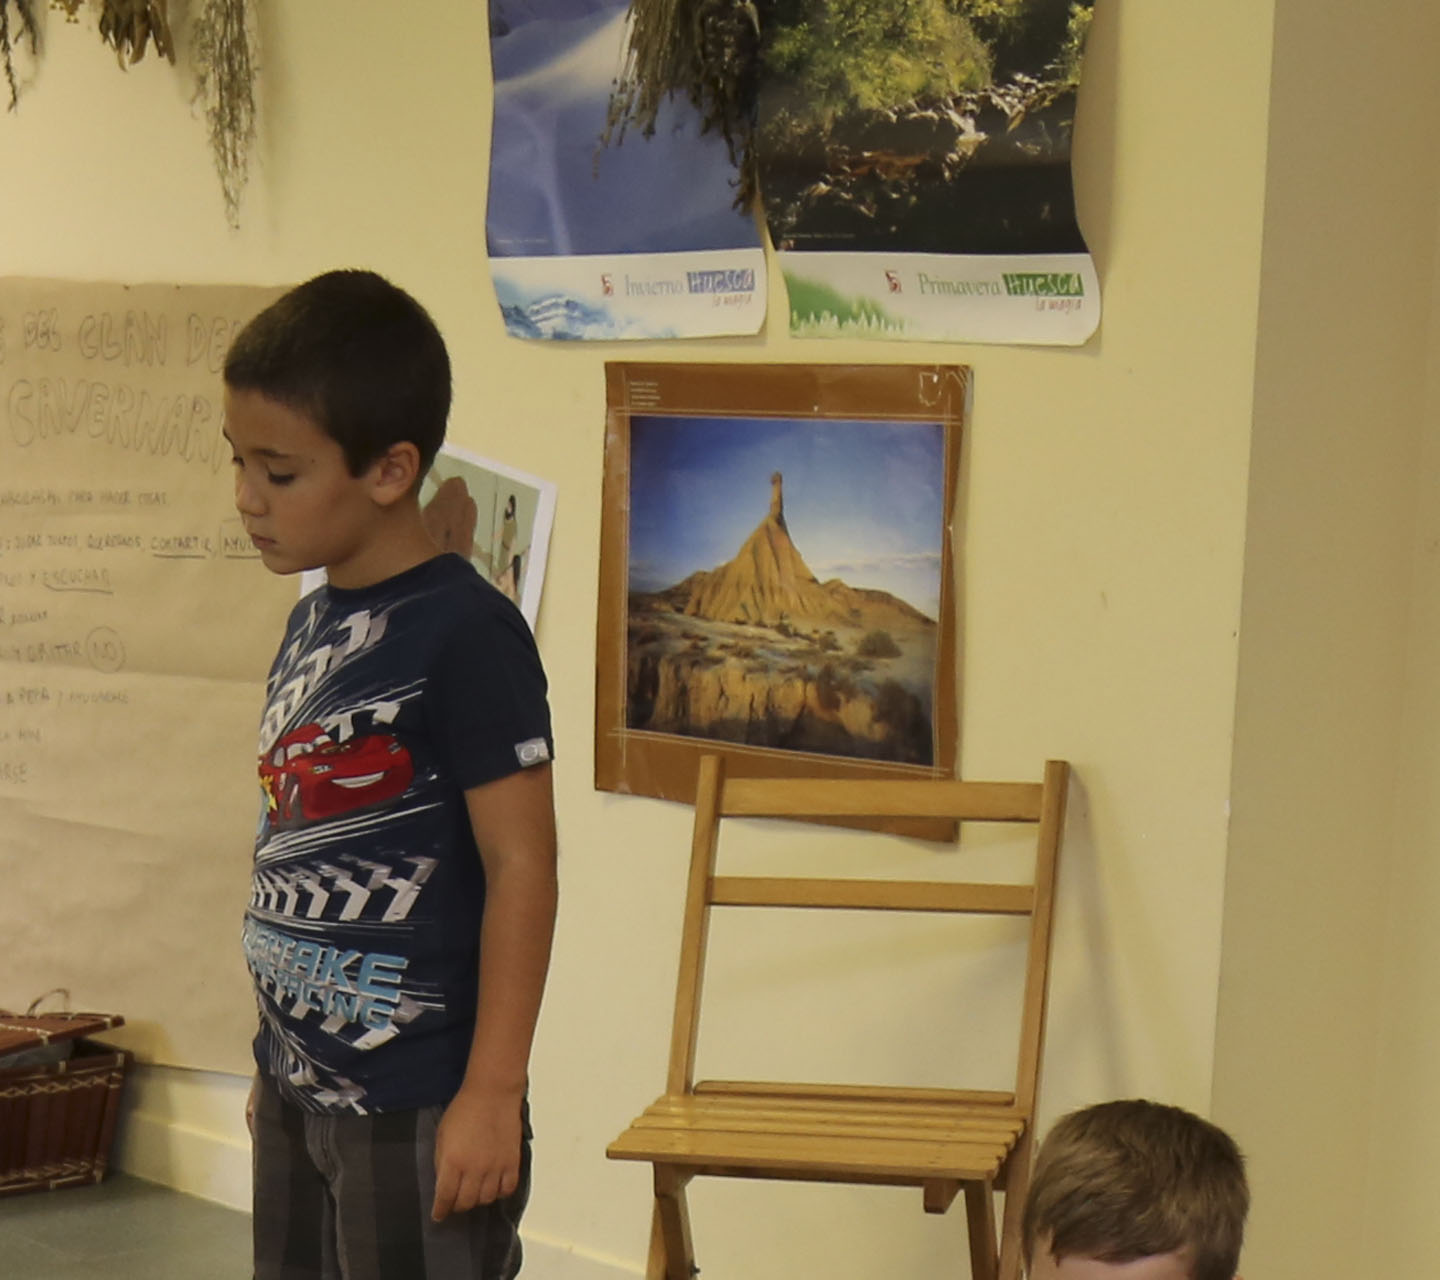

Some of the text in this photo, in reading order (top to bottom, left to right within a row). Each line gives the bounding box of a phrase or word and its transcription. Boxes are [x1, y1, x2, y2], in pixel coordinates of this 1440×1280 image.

[624, 269, 755, 297] Invierno Huesca
[918, 272, 1084, 297] Primavera Huesca
[79, 309, 168, 368] CLAN
